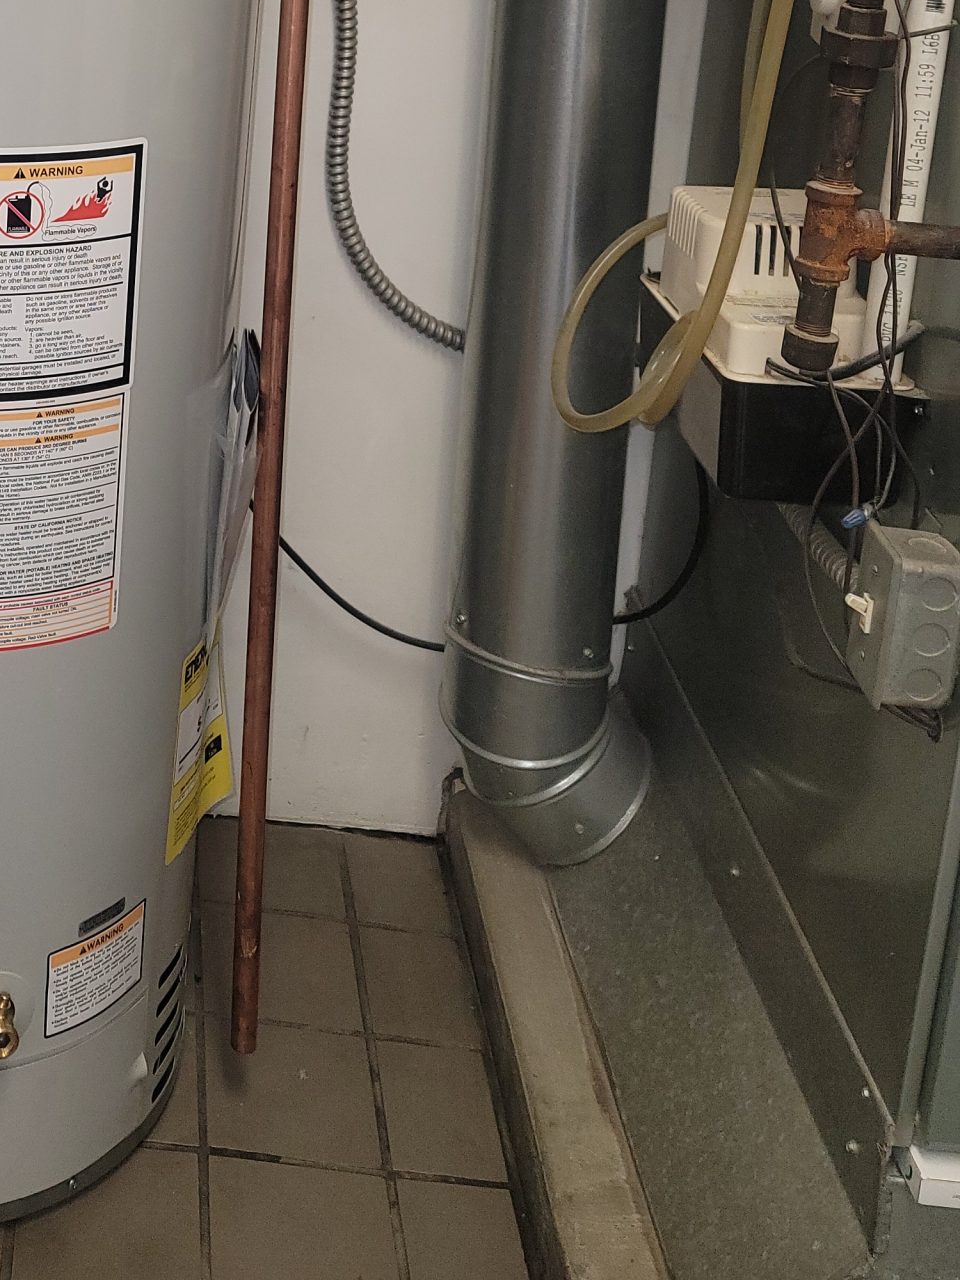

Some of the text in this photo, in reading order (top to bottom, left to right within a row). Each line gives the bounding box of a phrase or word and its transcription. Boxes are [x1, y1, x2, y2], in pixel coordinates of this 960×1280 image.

[914, 63, 936, 99] 11:59
[906, 109, 931, 171] 04-Jan-12
[29, 166, 83, 177] WARNING
[45, 226, 97, 236] Flammable Vapors
[26, 248, 64, 256] EXPLOSION
[65, 245, 92, 253] HAZARD
[52, 254, 66, 262] injury
[23, 263, 46, 271] gasoline
[69, 258, 94, 266] flammable
[44, 408, 75, 417] WARNING
[43, 433, 74, 442] WARNING
[33, 602, 68, 613] FAULT STATUS
[86, 923, 124, 951] WARNING
